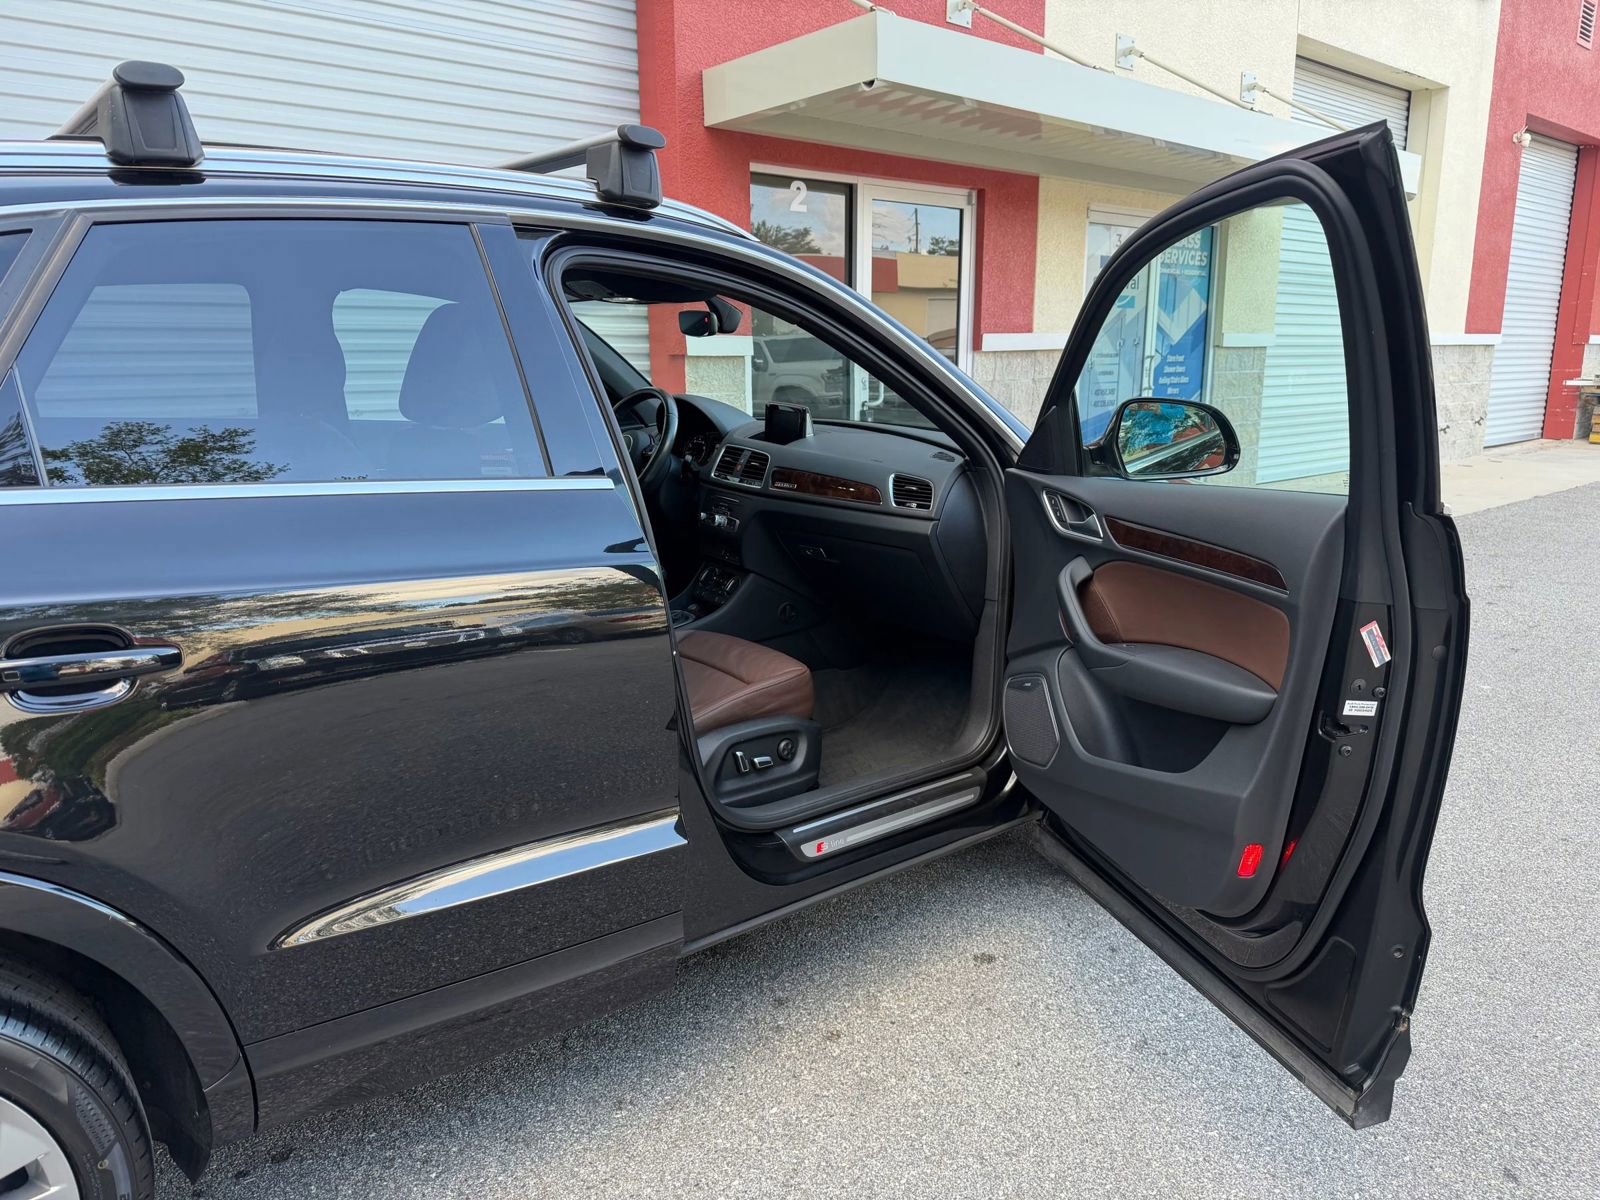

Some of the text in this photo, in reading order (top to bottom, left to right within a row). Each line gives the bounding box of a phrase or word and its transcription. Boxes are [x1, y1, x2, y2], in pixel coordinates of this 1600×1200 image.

[789, 180, 807, 212] 2
[1115, 233, 1122, 247] 3
[1173, 231, 1201, 248] ASS
[1159, 249, 1208, 266] SERVICES
